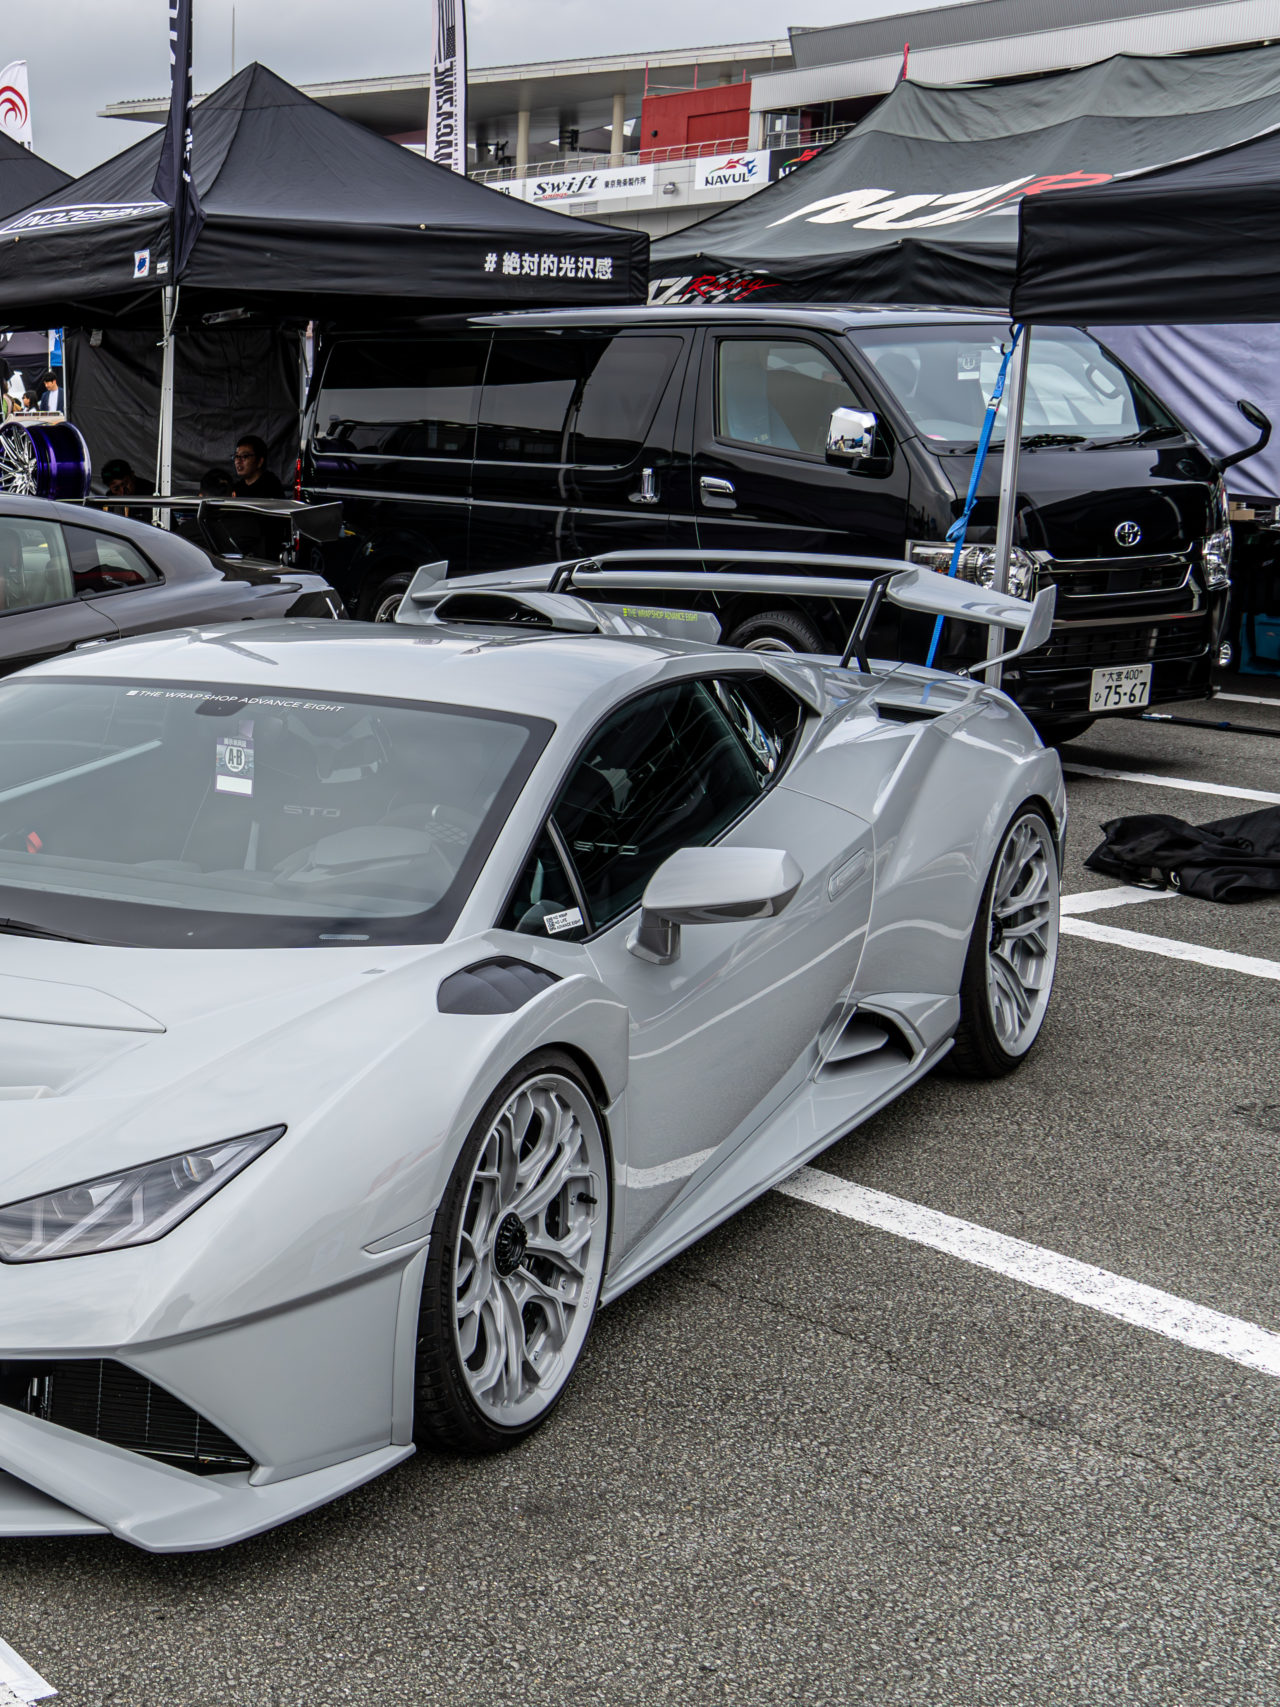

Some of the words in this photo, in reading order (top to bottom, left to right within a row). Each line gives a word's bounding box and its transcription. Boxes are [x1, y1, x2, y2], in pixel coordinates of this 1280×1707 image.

[502, 252, 612, 279] 絶対的光沢感
[1107, 671, 1123, 683] 大宮
[1124, 669, 1139, 680] 400
[138, 690, 163, 698] THE
[165, 691, 238, 703] WRAPSHOP
[239, 697, 302, 709] ADVANCE
[303, 702, 345, 713] EIGHT
[1104, 681, 1148, 706] 75-67
[283, 804, 342, 818] STO
[574, 840, 640, 856] STO
